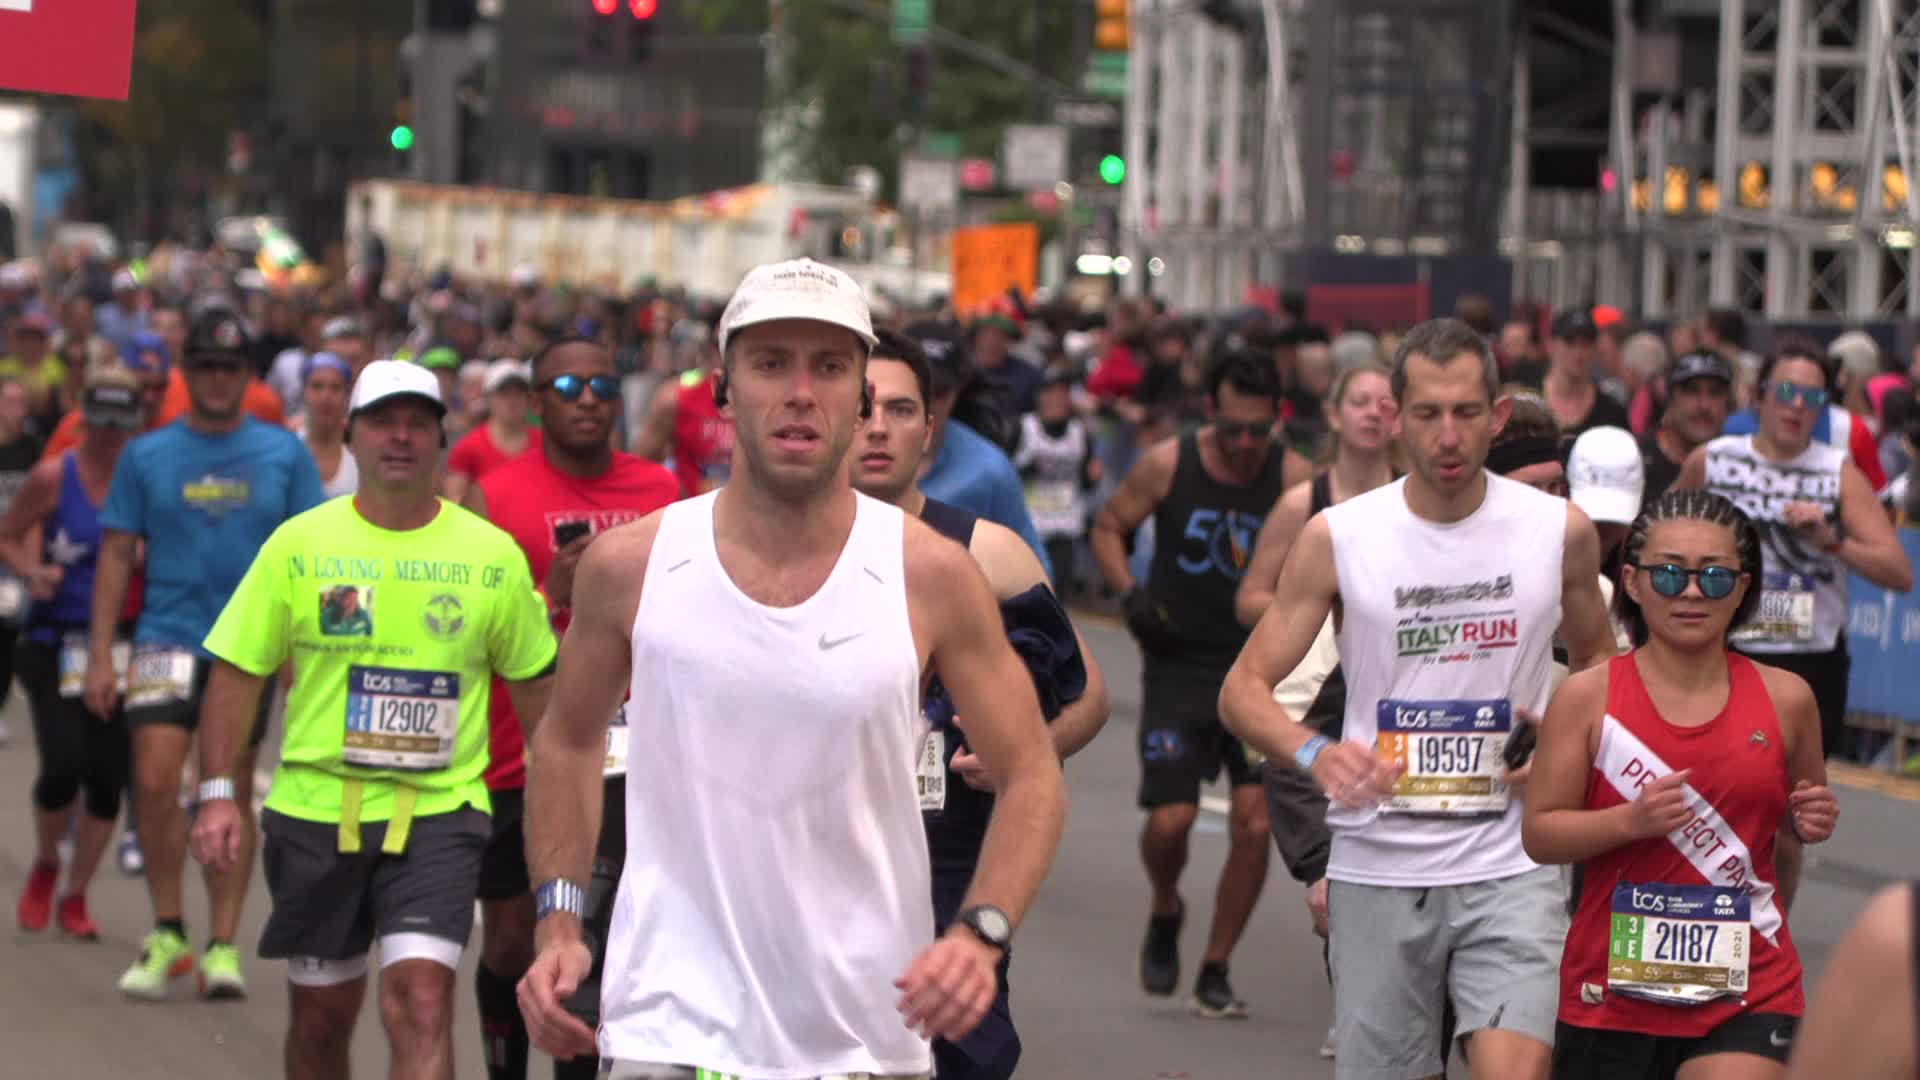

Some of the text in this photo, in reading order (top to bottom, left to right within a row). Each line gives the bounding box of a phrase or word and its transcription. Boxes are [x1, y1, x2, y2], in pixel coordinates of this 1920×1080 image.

[288, 556, 505, 590] IN LOVING MEMORY OF
[363, 671, 392, 692] tcs
[379, 700, 438, 734] 12902
[1395, 705, 1428, 729] tcs
[1418, 735, 1485, 774] 19597
[1632, 887, 1665, 912] tcs
[1713, 907, 1736, 916] TATA
[1628, 917, 1639, 935] 3
[1627, 940, 1638, 959] E
[1654, 922, 1719, 964] 21187
[1733, 931, 1743, 959] 2021
